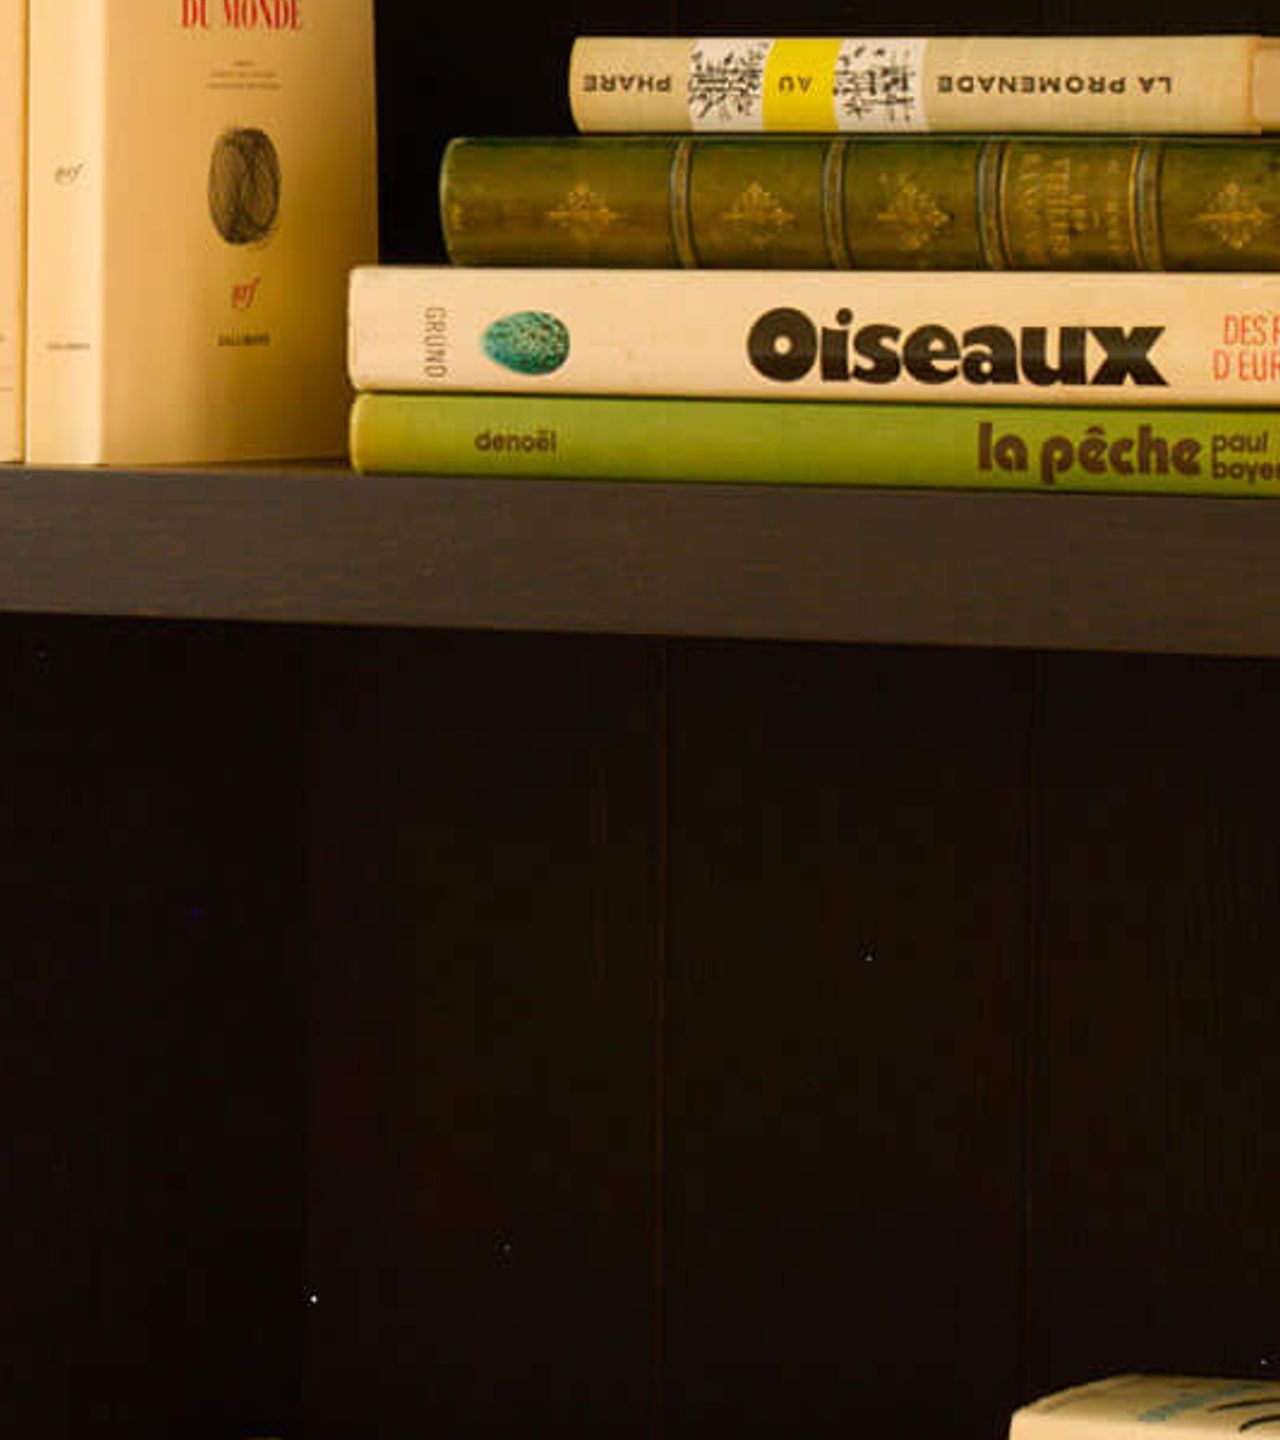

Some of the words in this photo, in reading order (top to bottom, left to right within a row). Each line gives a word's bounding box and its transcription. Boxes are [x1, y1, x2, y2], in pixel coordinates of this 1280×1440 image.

[583, 74, 673, 94] PHARE
[778, 75, 813, 94] AU
[937, 76, 1127, 94] PROMENADE
[1139, 76, 1172, 94] LA
[1224, 315, 1267, 347] DES
[746, 307, 1169, 387] Oiseaux
[474, 429, 557, 453] denoël
[1211, 431, 1269, 460] paul
[977, 421, 1028, 473] la
[1041, 422, 1201, 486] pêche
